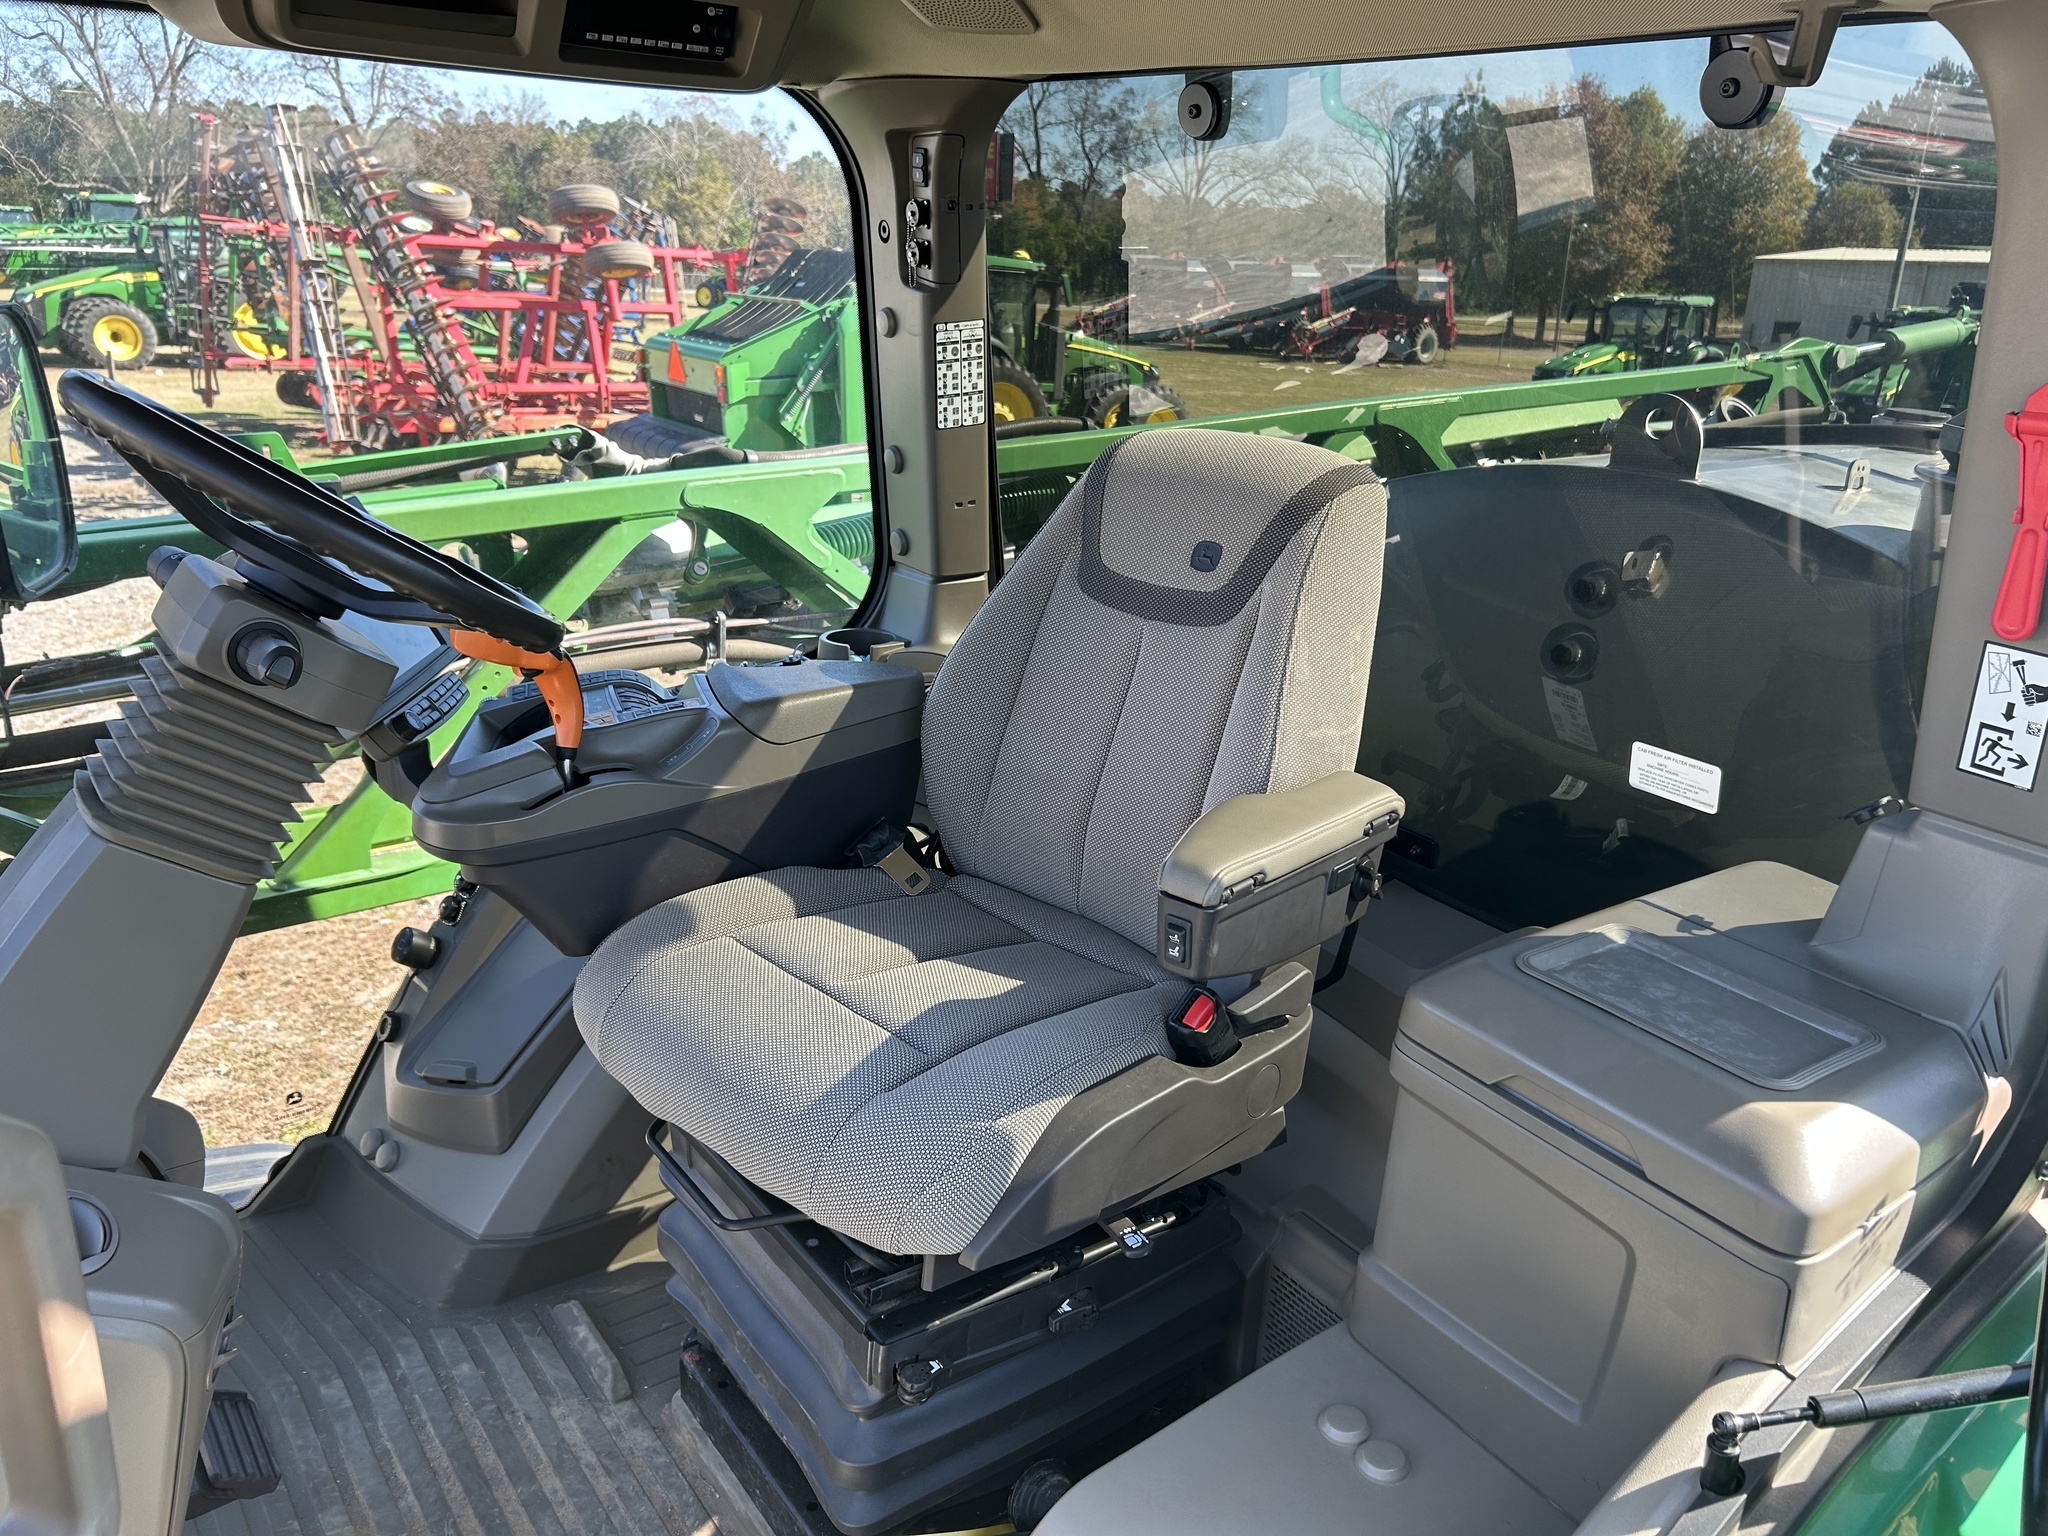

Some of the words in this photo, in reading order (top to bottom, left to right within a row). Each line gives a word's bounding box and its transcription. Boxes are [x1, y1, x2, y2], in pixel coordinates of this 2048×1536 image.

[1648, 750, 1663, 759] FRESH
[1672, 758, 1687, 766] FILTER
[1688, 763, 1713, 775] INSTALLED
